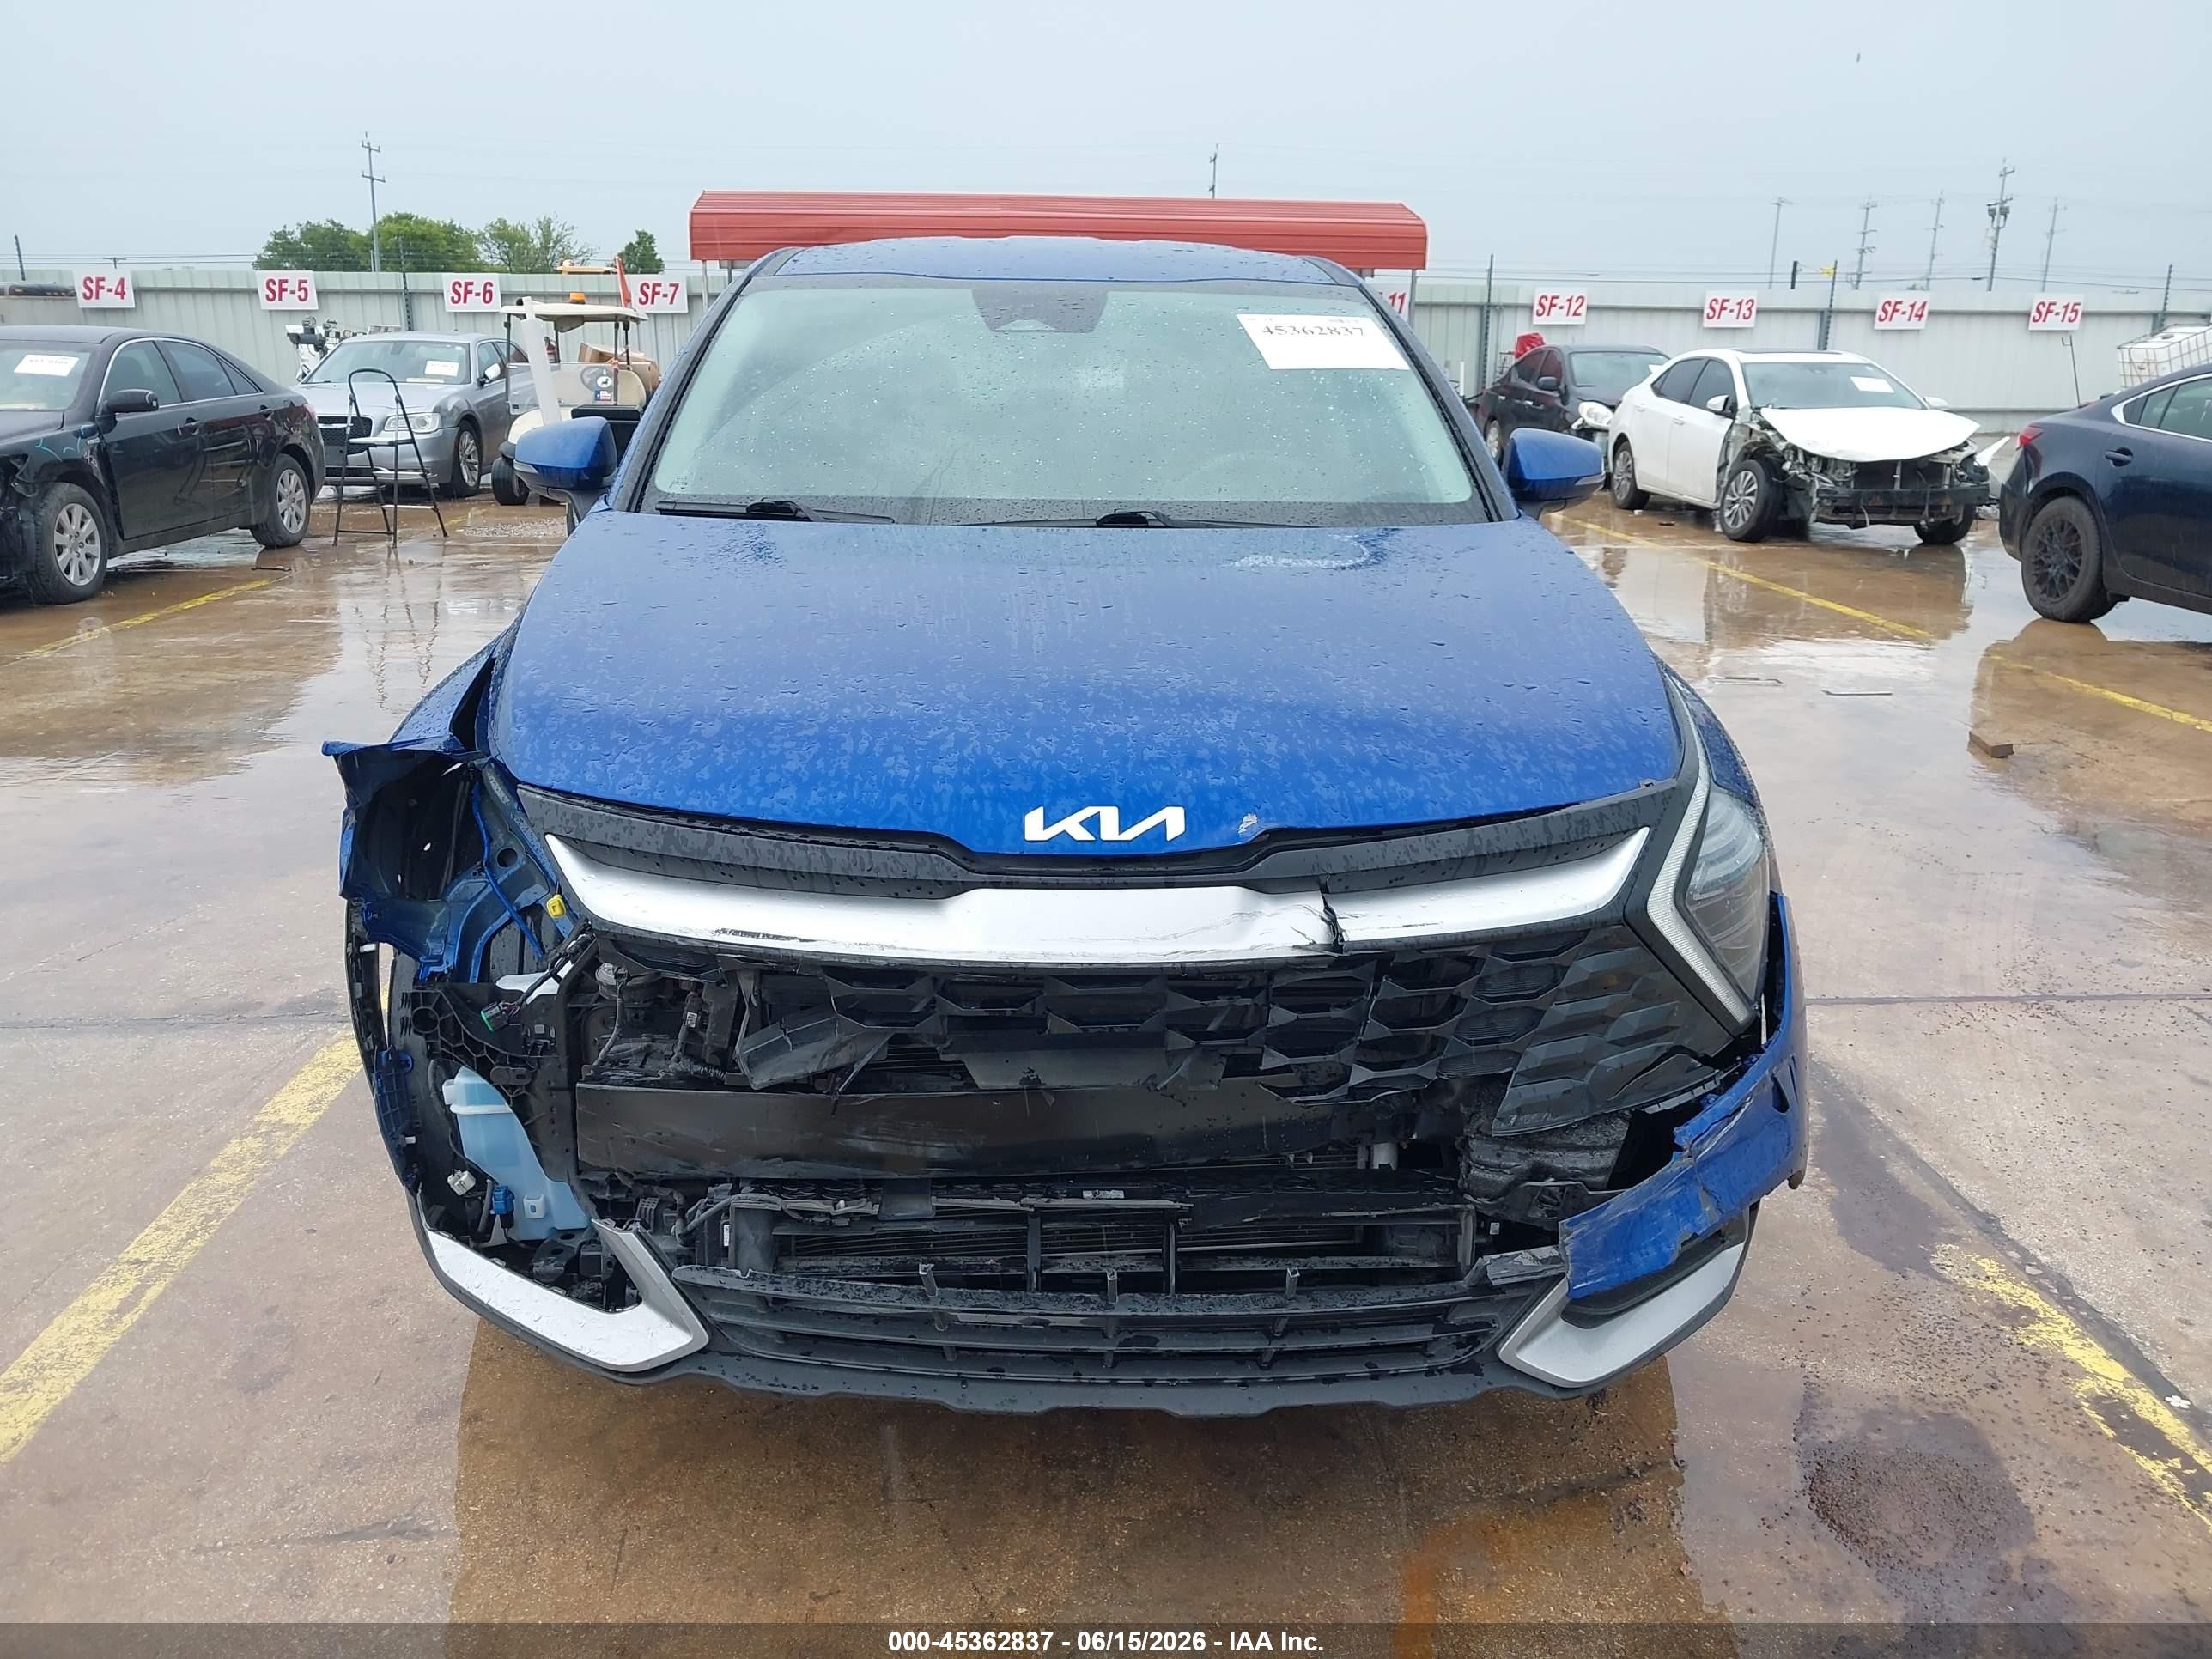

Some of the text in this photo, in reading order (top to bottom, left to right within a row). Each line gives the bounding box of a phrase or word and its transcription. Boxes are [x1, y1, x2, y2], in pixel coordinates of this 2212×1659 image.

[83, 276, 126, 301] SF-4
[265, 279, 308, 303] SF-5
[451, 281, 495, 305] SF-6
[638, 283, 679, 307] SF-7
[1537, 294, 1585, 317] SF-12
[1706, 297, 1755, 320] SF-13
[1878, 301, 1928, 323] SF-14
[2032, 301, 2081, 324] SF-15
[1262, 325, 1365, 337] 45362837
